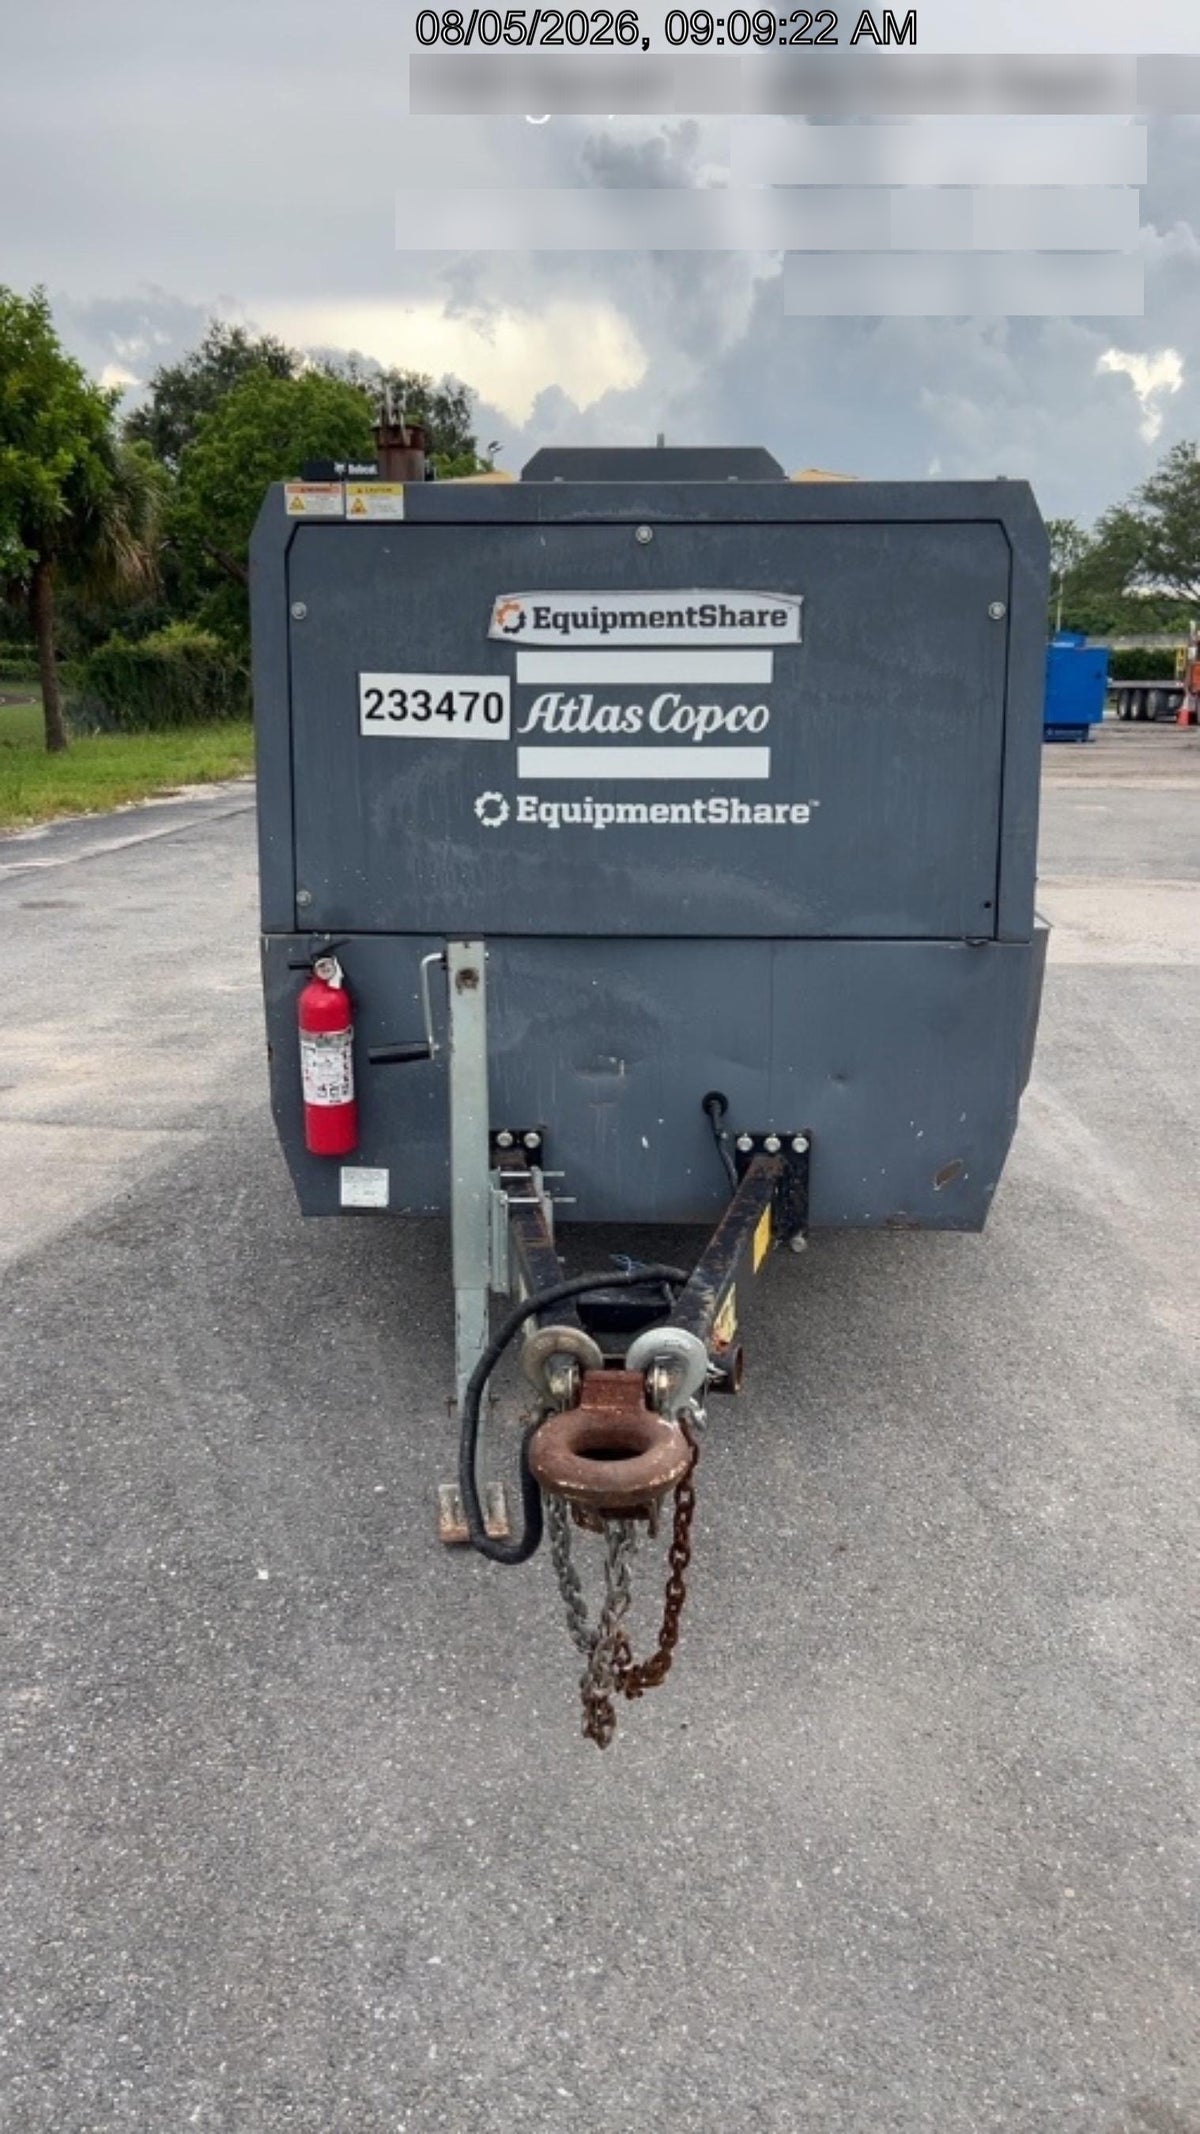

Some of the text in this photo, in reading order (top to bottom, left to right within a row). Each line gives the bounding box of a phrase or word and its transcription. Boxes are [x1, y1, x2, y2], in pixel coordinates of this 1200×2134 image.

[364, 688, 504, 724] 233470
[518, 692, 769, 741] Atlas Copco
